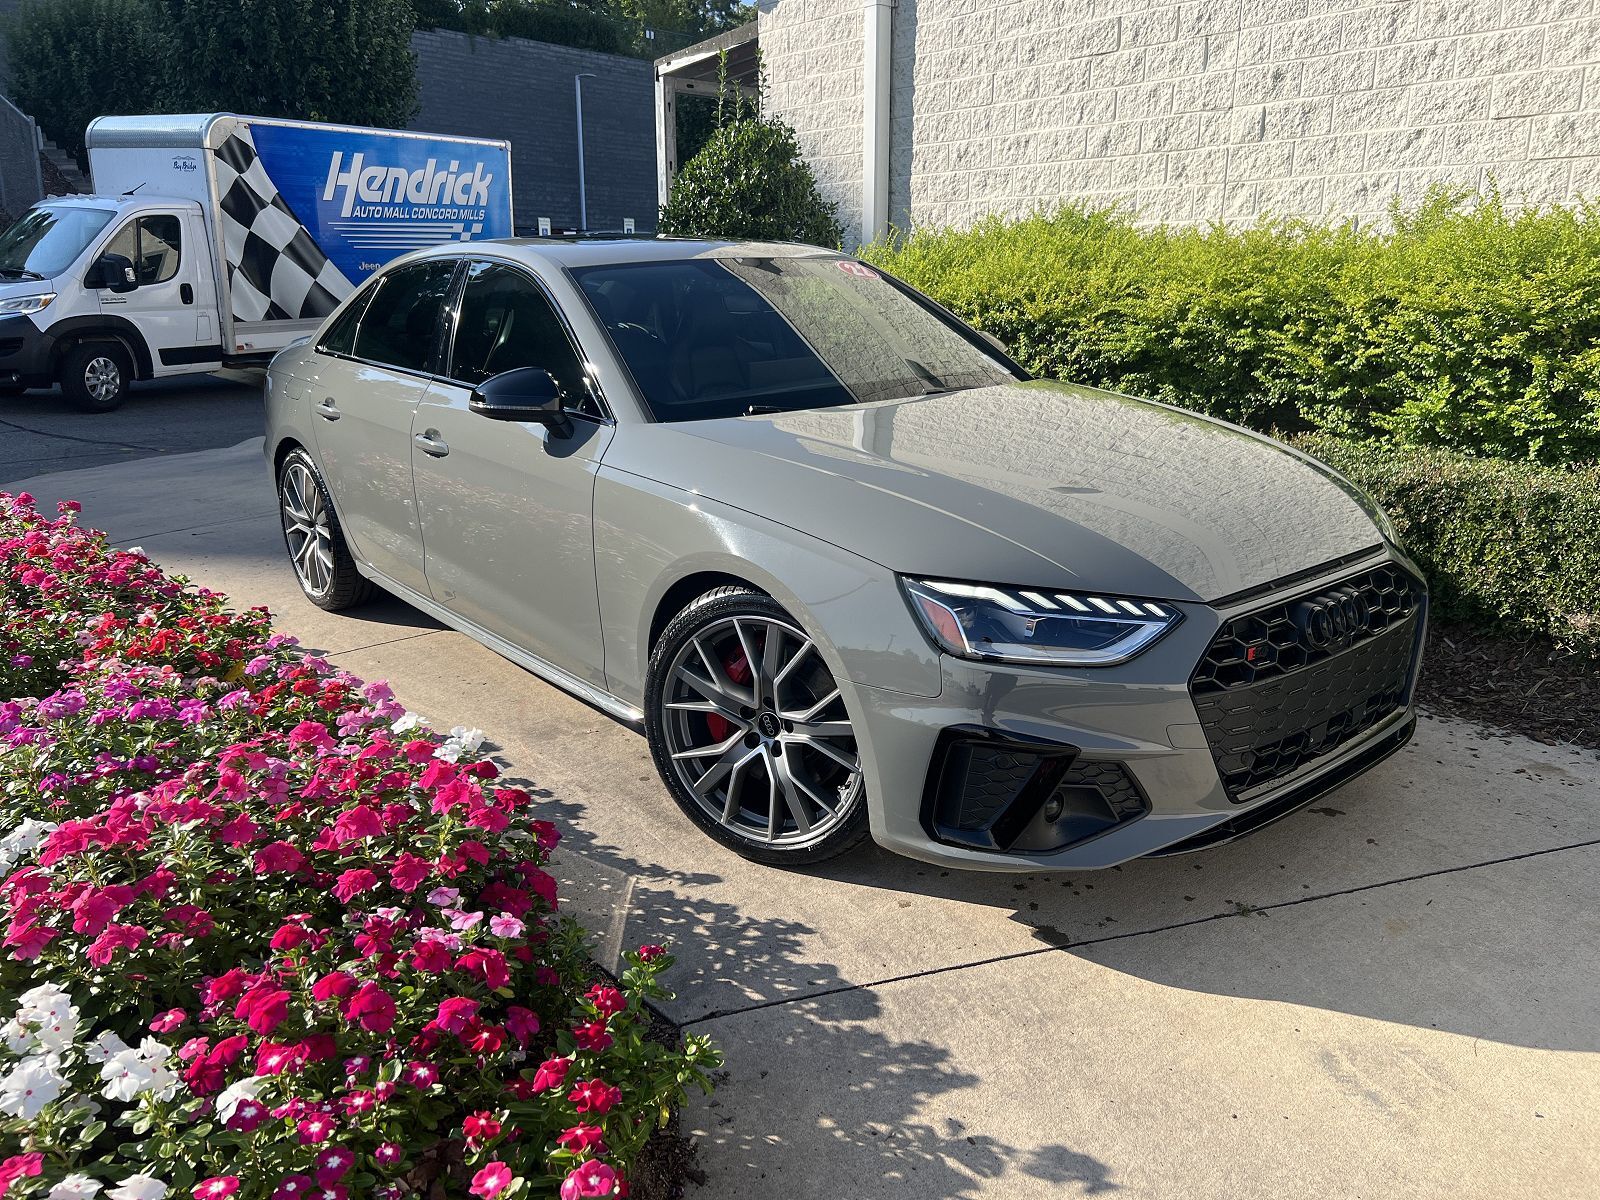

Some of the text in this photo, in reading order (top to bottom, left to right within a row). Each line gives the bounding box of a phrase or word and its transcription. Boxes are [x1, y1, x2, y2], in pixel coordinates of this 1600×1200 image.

[323, 151, 493, 217] Hendrick
[352, 206, 486, 221] AUTO MALL CONCORD MILLS
